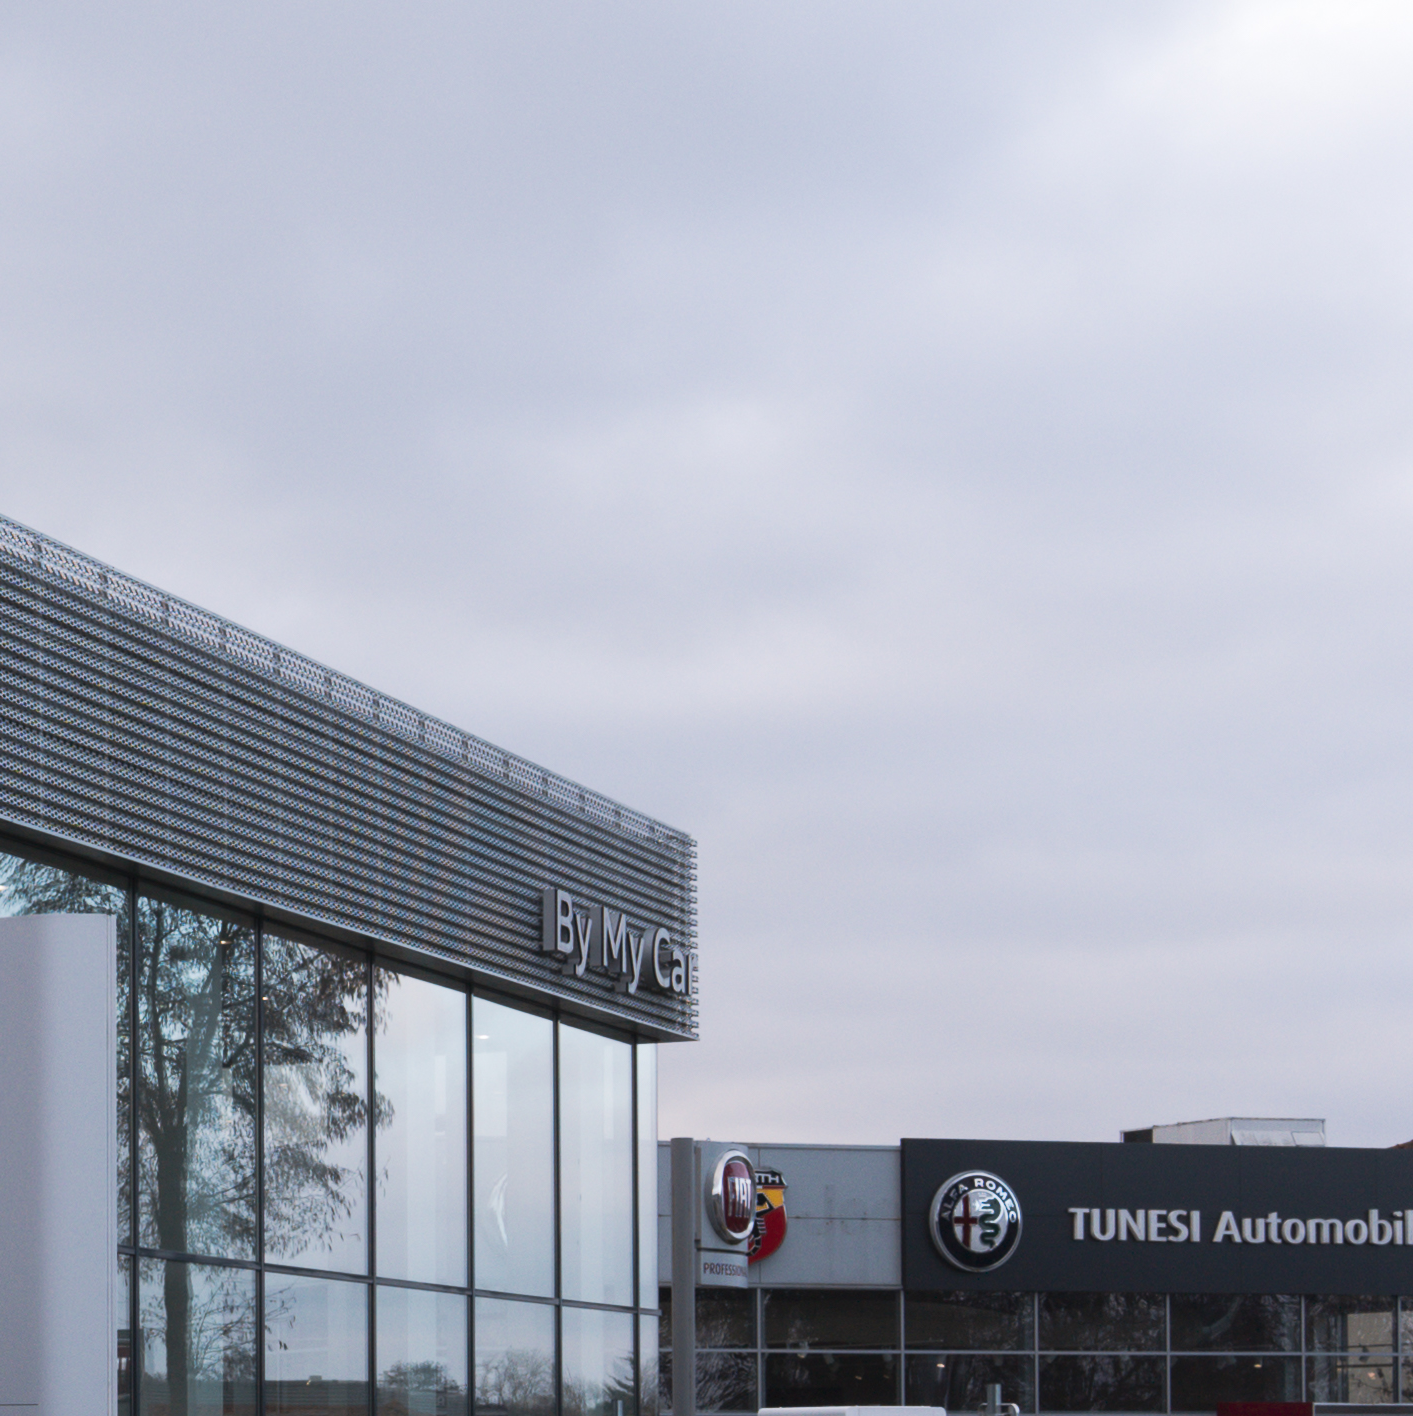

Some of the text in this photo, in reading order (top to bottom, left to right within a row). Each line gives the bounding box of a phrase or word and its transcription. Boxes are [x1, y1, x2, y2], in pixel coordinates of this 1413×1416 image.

[549, 887, 593, 977] By
[593, 905, 644, 995] My
[727, 1176, 752, 1218] FIAT
[940, 1177, 1018, 1223] ALFA ROMEO
[1068, 1207, 1201, 1243] TUNESI
